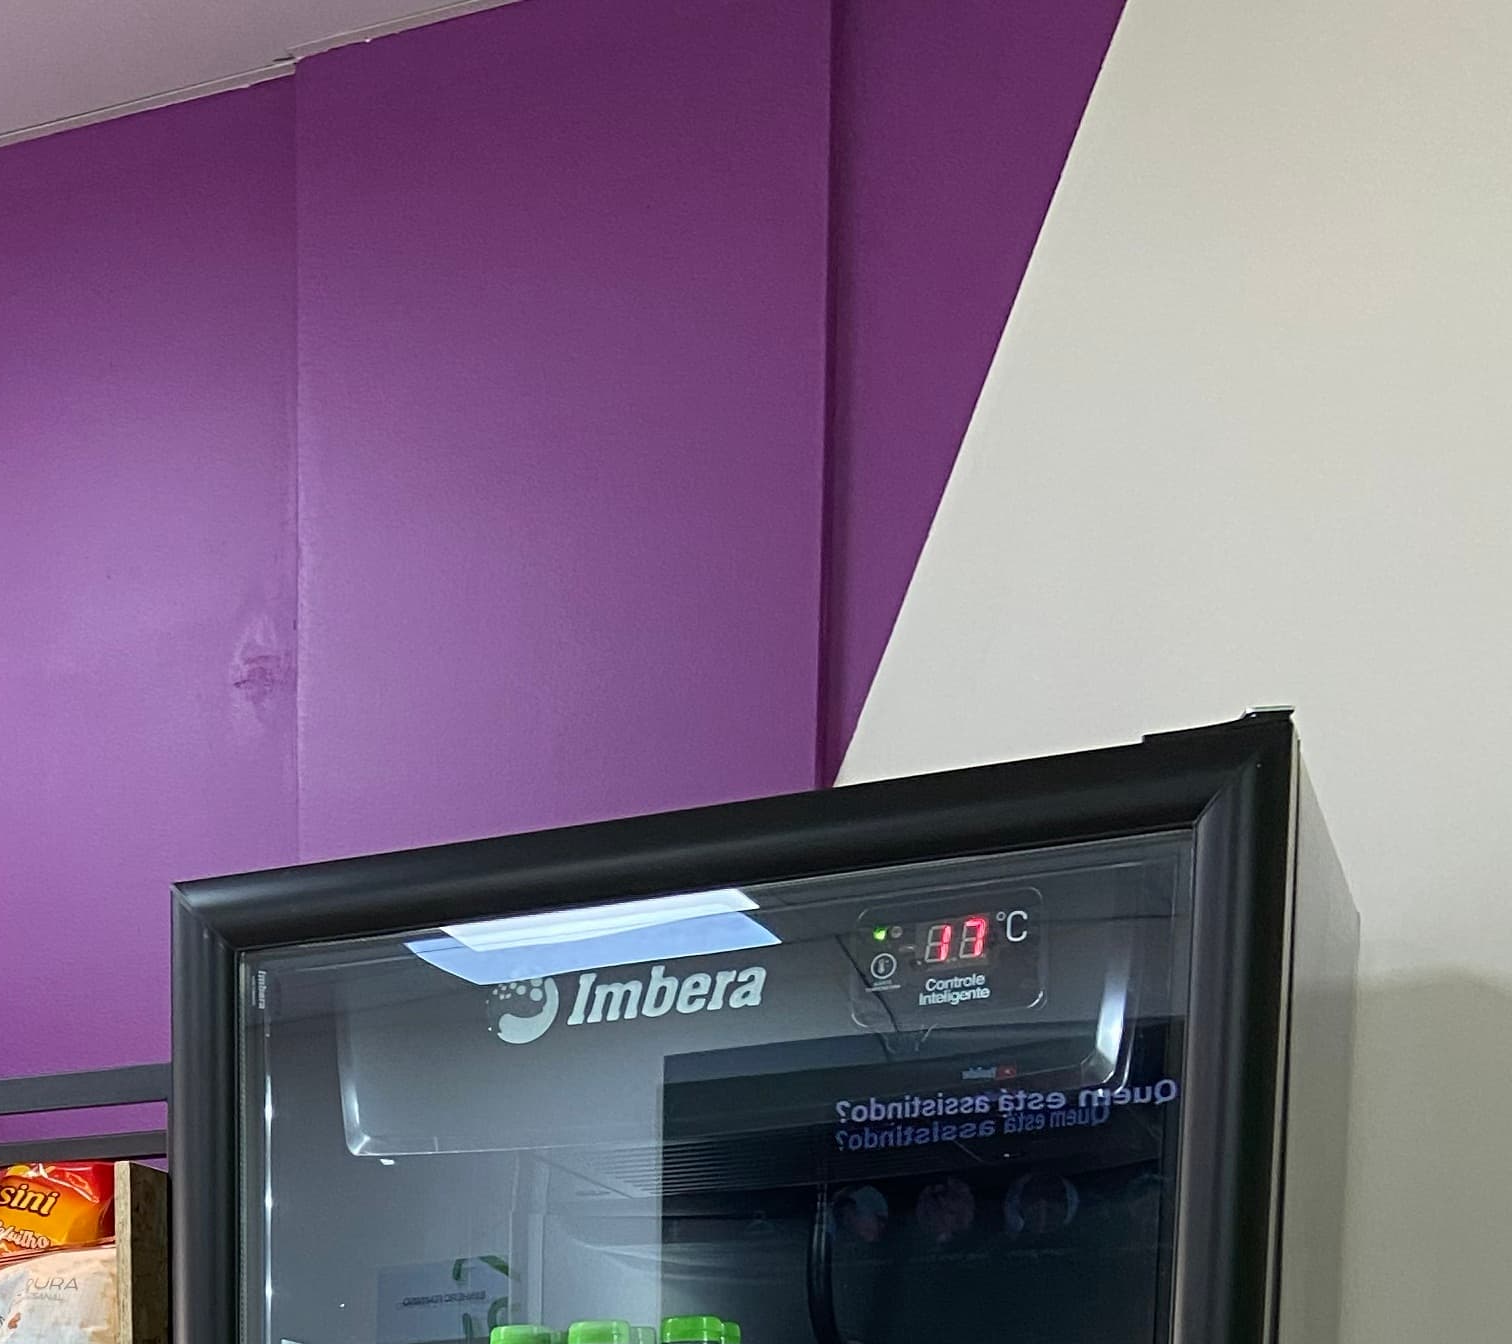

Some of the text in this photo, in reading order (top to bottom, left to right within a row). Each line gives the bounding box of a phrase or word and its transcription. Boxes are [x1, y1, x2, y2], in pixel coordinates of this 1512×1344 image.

[925, 973, 986, 992] Controle
[567, 964, 769, 1026] Imbera
[918, 987, 991, 1006] Inteligente
